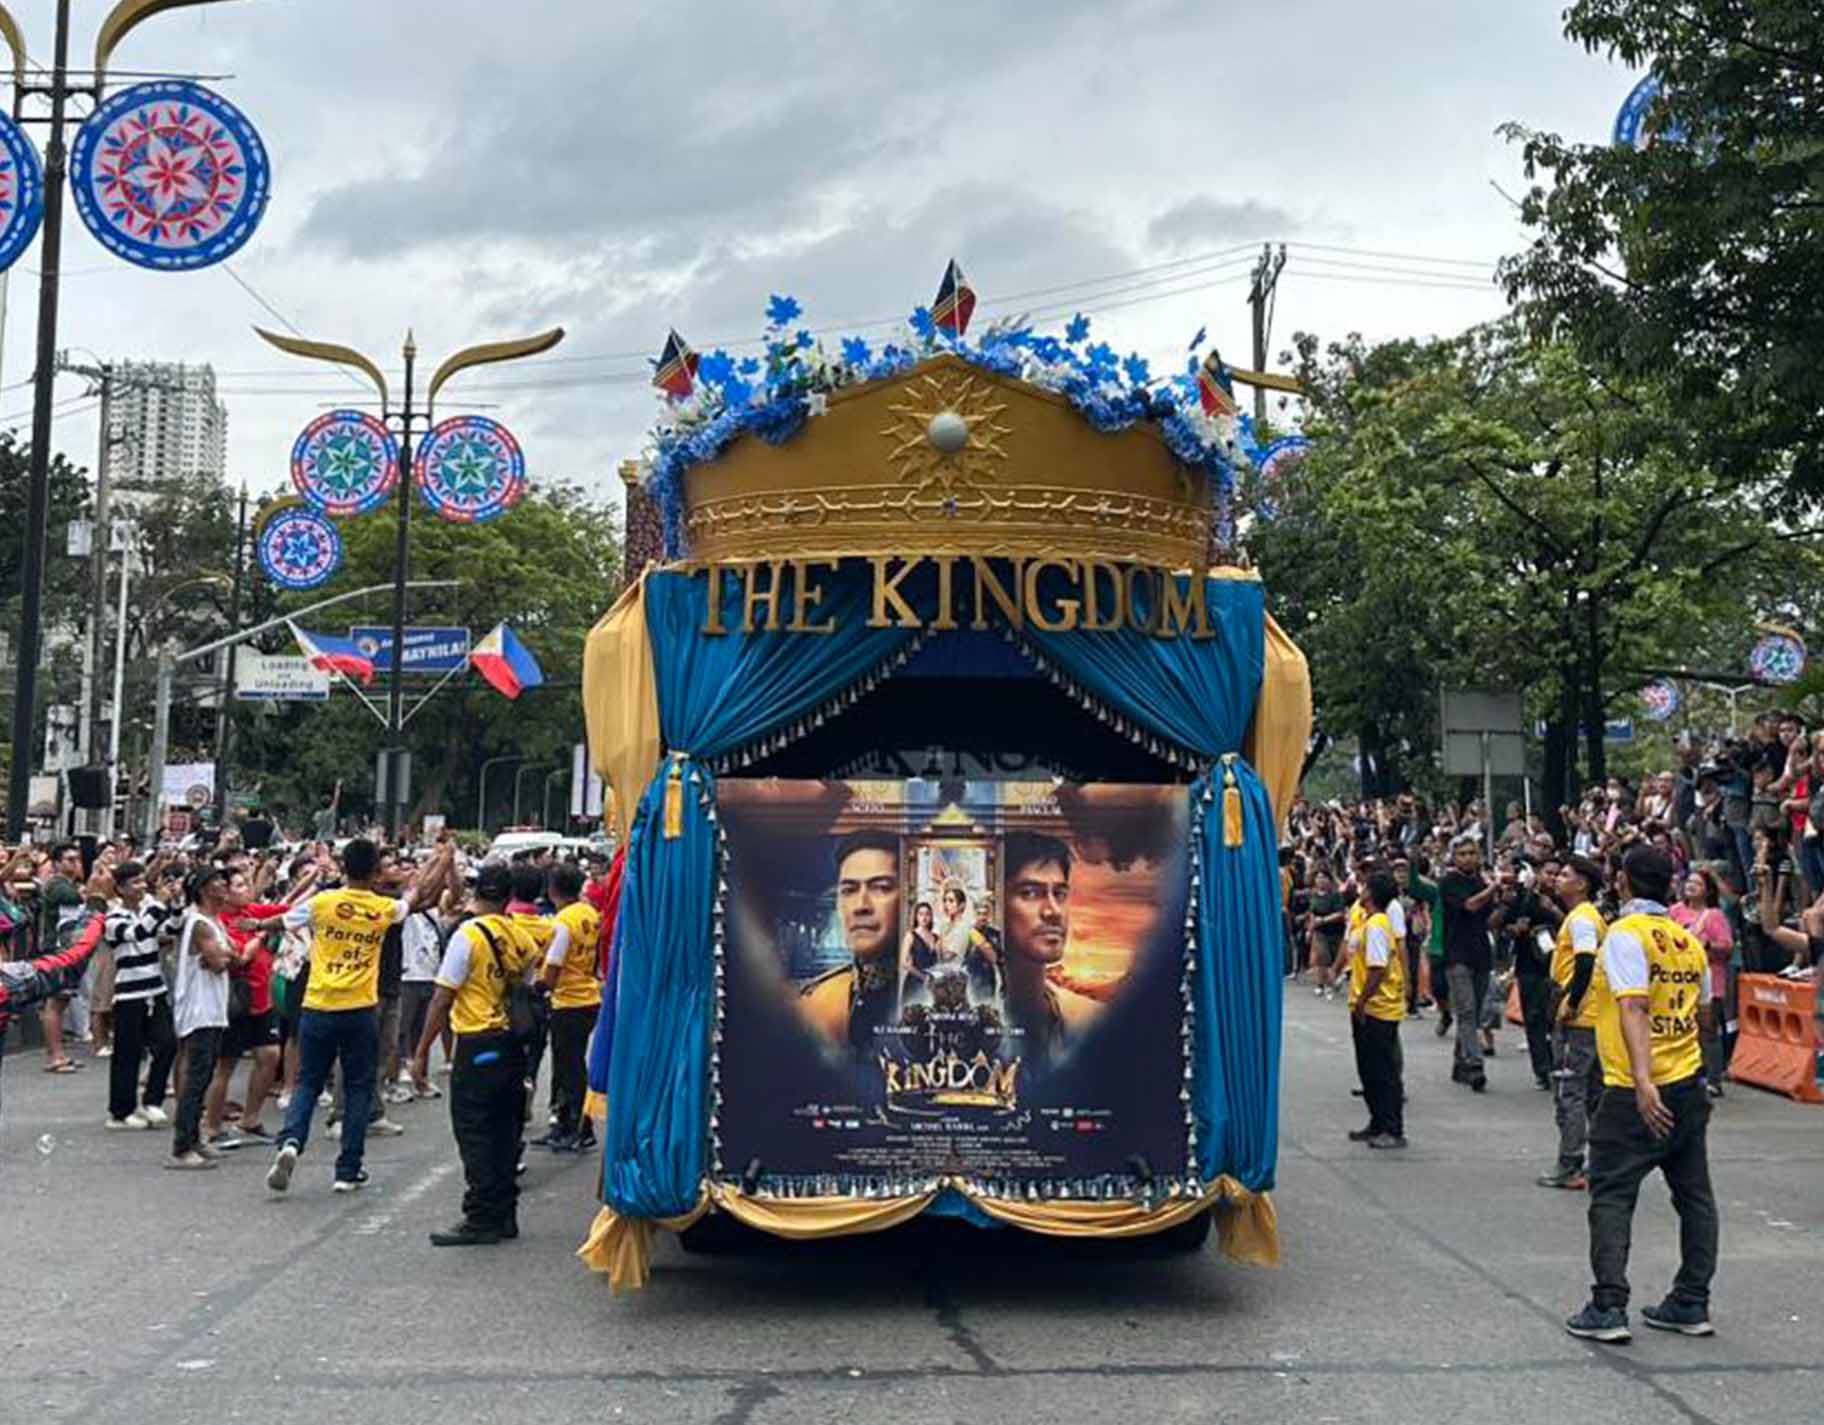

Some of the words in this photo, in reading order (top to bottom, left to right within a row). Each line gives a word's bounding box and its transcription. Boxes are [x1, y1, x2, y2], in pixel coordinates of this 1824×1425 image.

[688, 556, 838, 635] THE
[866, 553, 1216, 639] KINGDOM
[343, 946, 361, 960] of
[880, 1050, 1020, 1093] KINGDOM
